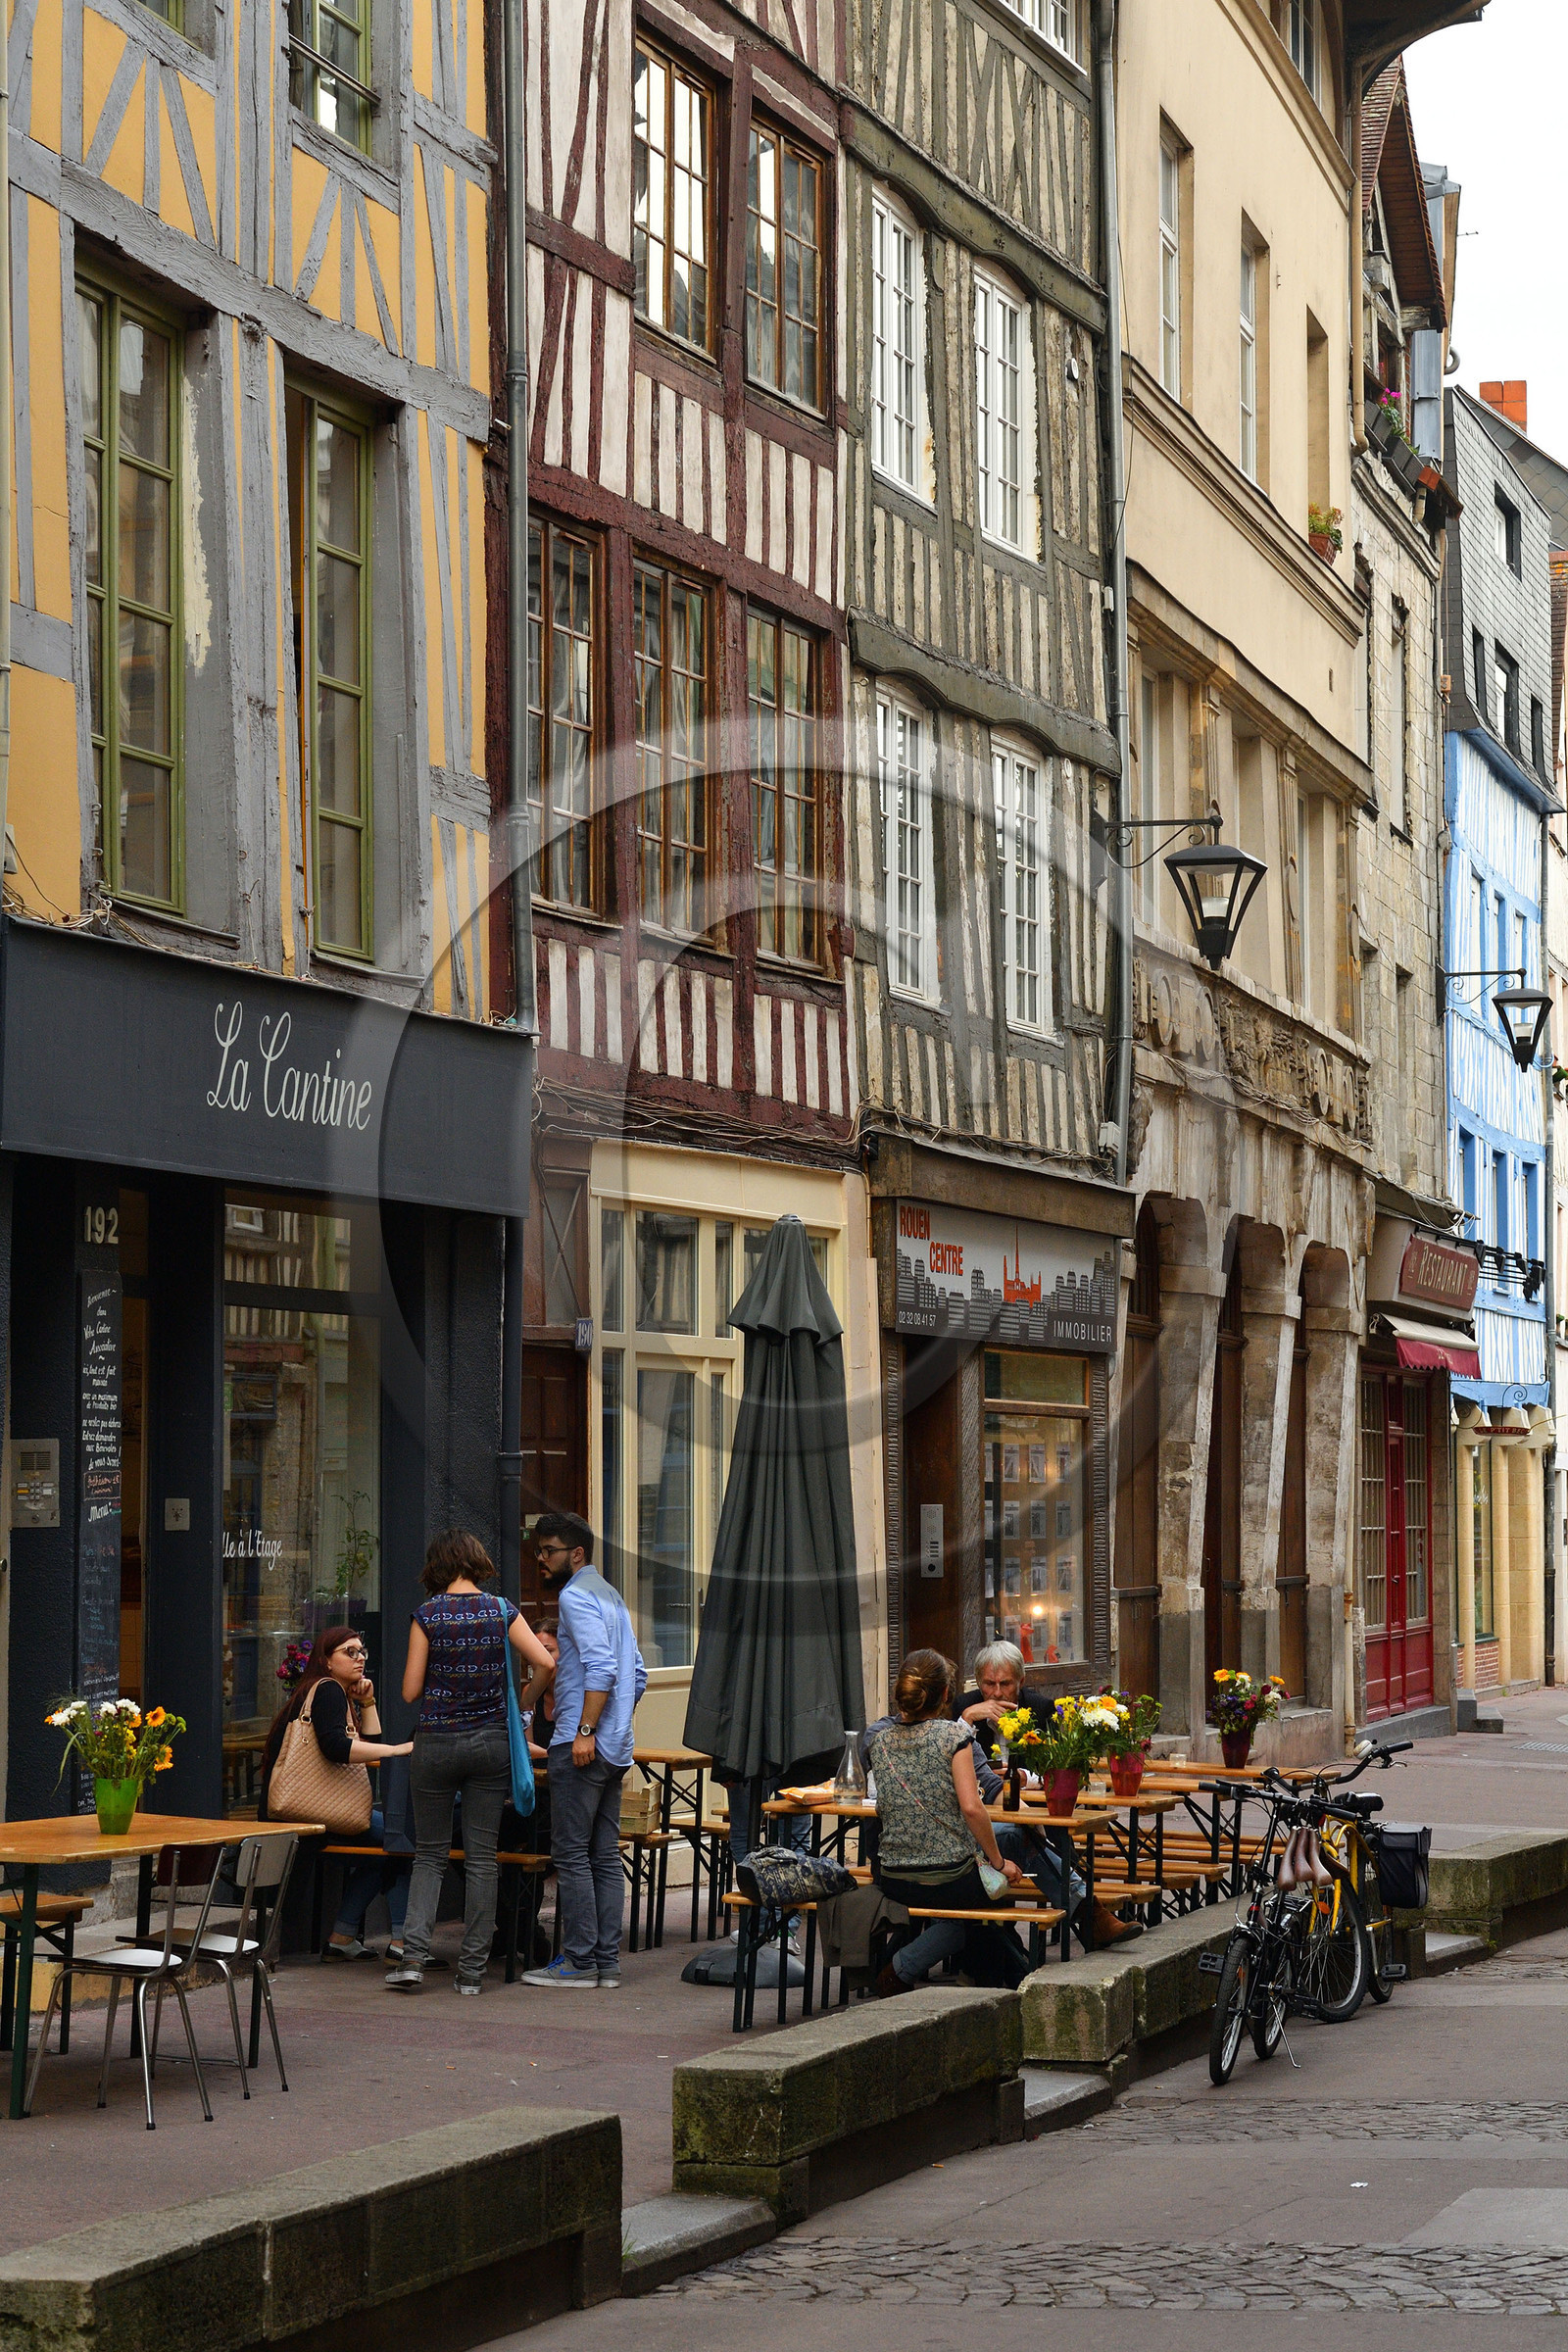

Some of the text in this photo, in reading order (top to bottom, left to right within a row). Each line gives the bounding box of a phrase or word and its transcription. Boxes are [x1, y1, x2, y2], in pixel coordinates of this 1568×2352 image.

[207, 1001, 371, 1130] La Cantine
[83, 1205, 119, 1244] 192
[900, 1204, 930, 1241] ROUEN
[929, 1241, 964, 1277] CENTRE
[1417, 1244, 1468, 1296] RESTAURANT
[577, 1323, 593, 1347] 190
[898, 1310, 906, 1323] 02
[906, 1311, 913, 1324] 32
[921, 1313, 928, 1326] 41
[929, 1314, 936, 1327] 57
[1054, 1320, 1112, 1343] IMMOBILIER
